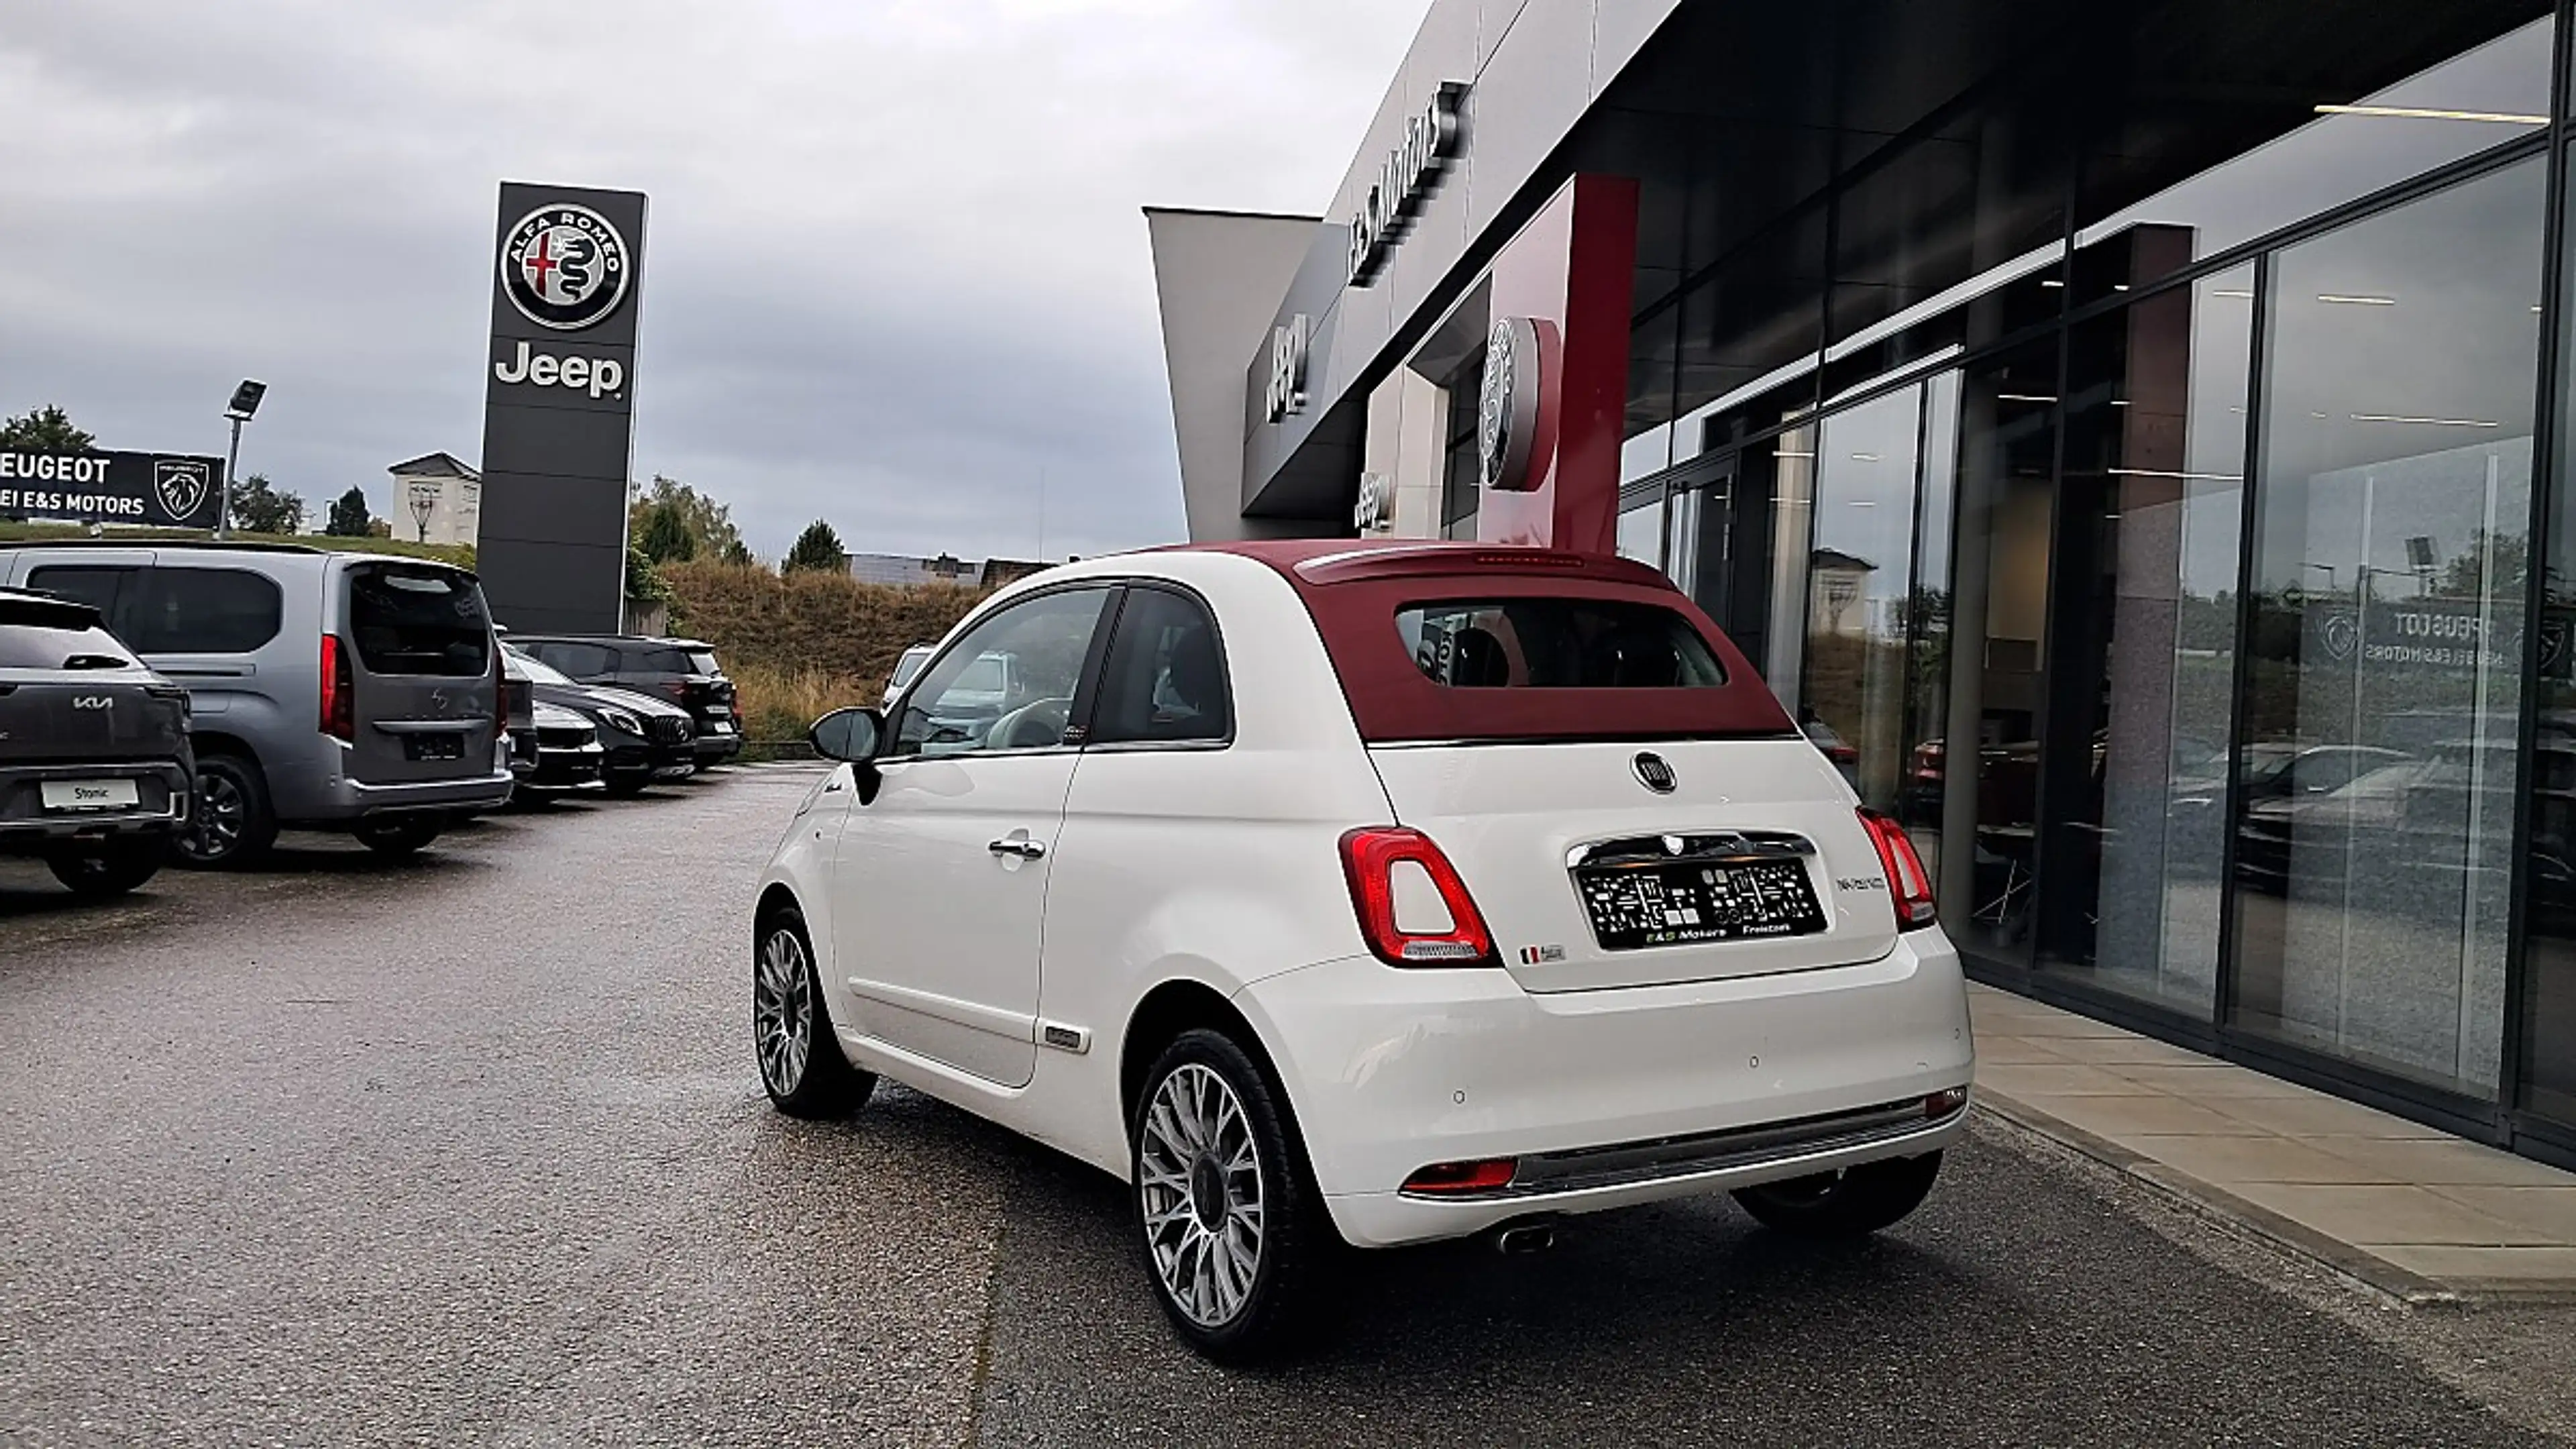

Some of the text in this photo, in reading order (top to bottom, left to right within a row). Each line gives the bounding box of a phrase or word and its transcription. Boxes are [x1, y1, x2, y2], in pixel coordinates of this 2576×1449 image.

[511, 212, 620, 272] ALFA ROMEO
[23, 490, 61, 511] E&S
[66, 493, 145, 515] MOTORS
